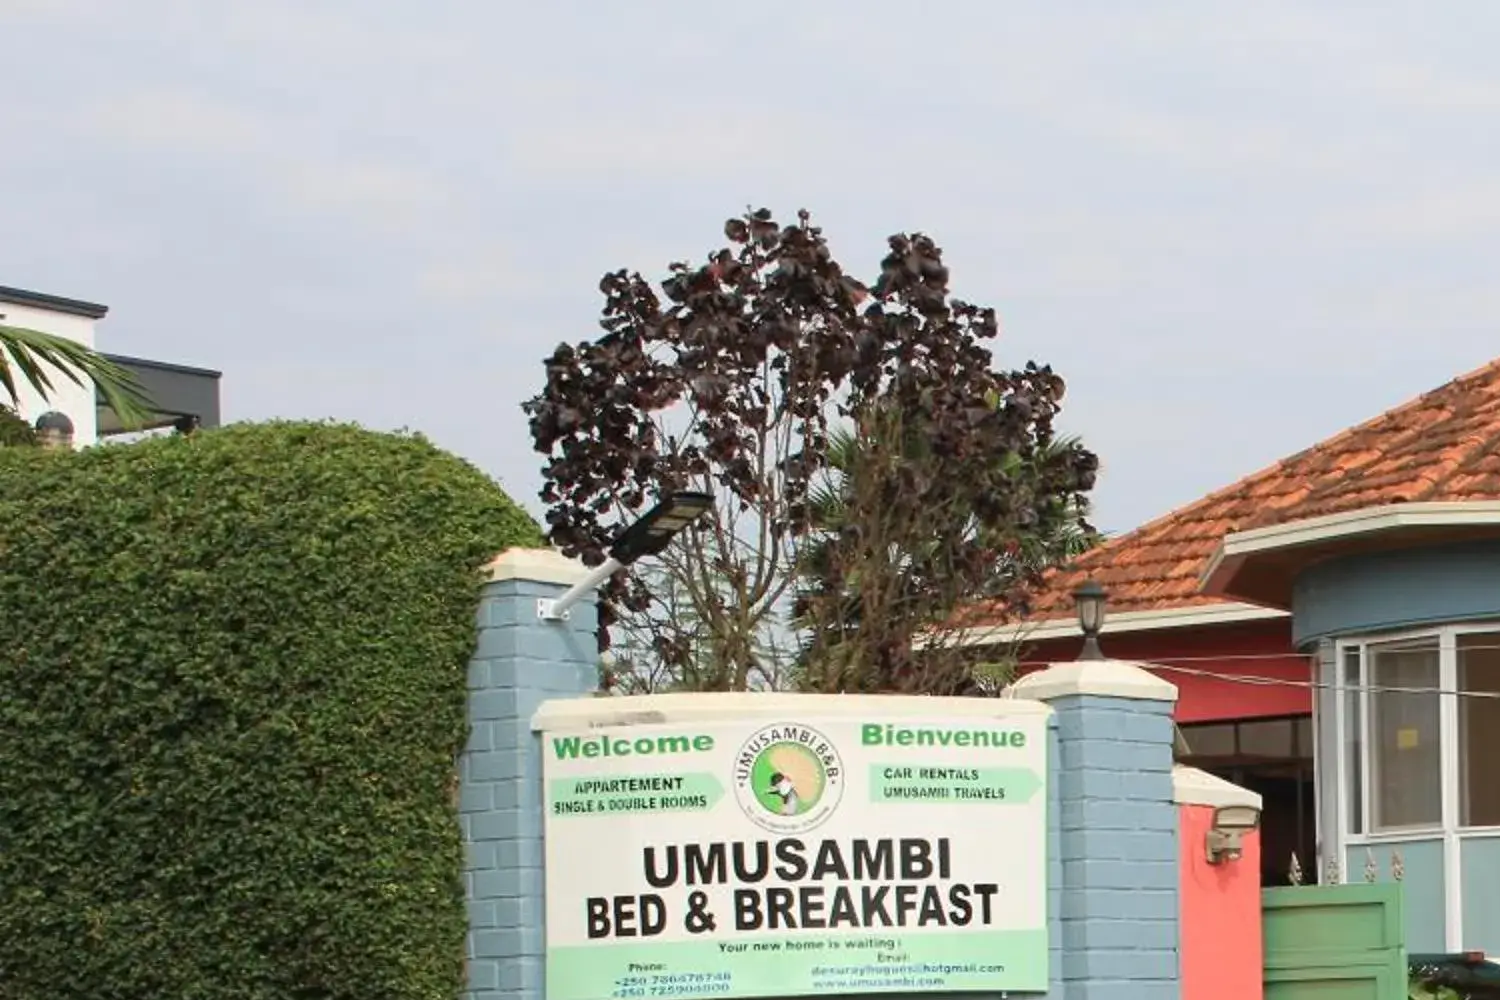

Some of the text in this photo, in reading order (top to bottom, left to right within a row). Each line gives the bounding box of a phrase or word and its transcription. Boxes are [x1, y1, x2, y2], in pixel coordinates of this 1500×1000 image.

[861, 724, 1026, 747] Bienvenue
[553, 734, 714, 760] Welcome
[736, 727, 839, 781] UMUSAMBI B&B
[883, 767, 980, 781] CAR RENTALS
[574, 777, 684, 794] APPARTEMENT
[883, 787, 1006, 799] UMUSAMBI TRAVELS
[553, 800, 594, 815] SINGLE
[609, 797, 657, 811] DOUBLE
[661, 795, 708, 808] ROOMS
[643, 837, 951, 888] UMUSAMBI
[586, 883, 999, 939] BED & BREAKFAST
[718, 942, 748, 953] Your
[753, 942, 781, 952] new
[785, 939, 825, 950] home
[829, 938, 840, 949] is
[628, 962, 668, 972] Phone:
